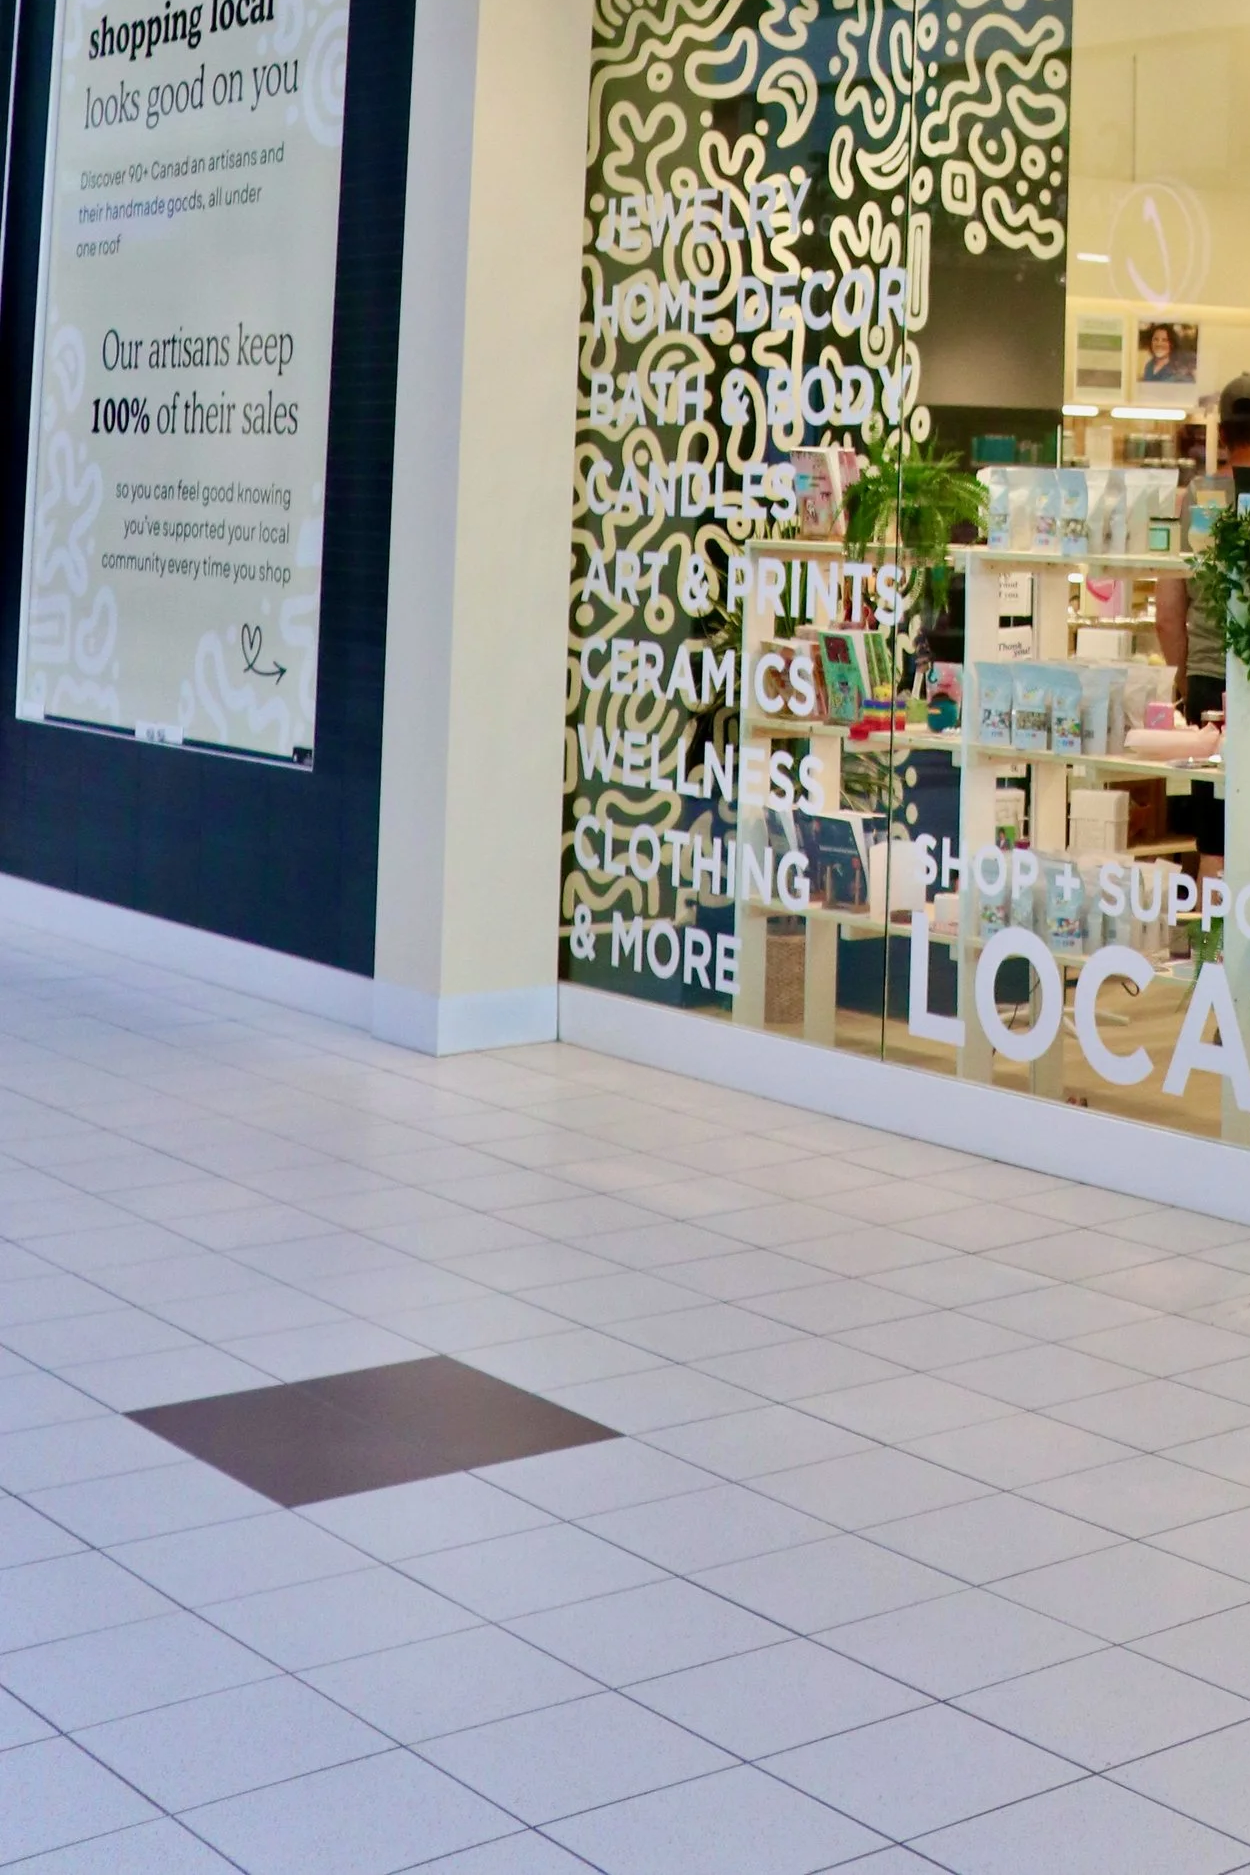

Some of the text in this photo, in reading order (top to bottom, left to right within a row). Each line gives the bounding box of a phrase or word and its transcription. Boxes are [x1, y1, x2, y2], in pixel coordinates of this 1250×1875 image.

[88, 0, 203, 61] shopping
[83, 58, 299, 129] looks good on you
[80, 141, 285, 191] Discover 90+ Canadan artisans and
[78, 183, 263, 225] their handmade goods, all under
[595, 177, 812, 253] JEWELRY
[76, 233, 122, 259] one roof
[593, 267, 908, 338] HOME DECOR
[102, 321, 294, 376] Our artisans keep
[91, 390, 300, 437] 100% of their sales
[589, 363, 914, 427] BATH & BODY
[115, 480, 292, 511] so you can feel good knowing
[585, 459, 799, 521] CANDLES
[123, 515, 290, 546] you've supported your local
[101, 551, 292, 587] community every time you shop
[580, 549, 905, 626] ART & PRINTS
[580, 637, 816, 717] CERAMICS
[577, 722, 826, 817] WELLNESS
[573, 814, 811, 912] CLOTHING
[914, 832, 1039, 901] SHOP
[1055, 862, 1081, 902] +
[569, 903, 743, 996] & MORE
